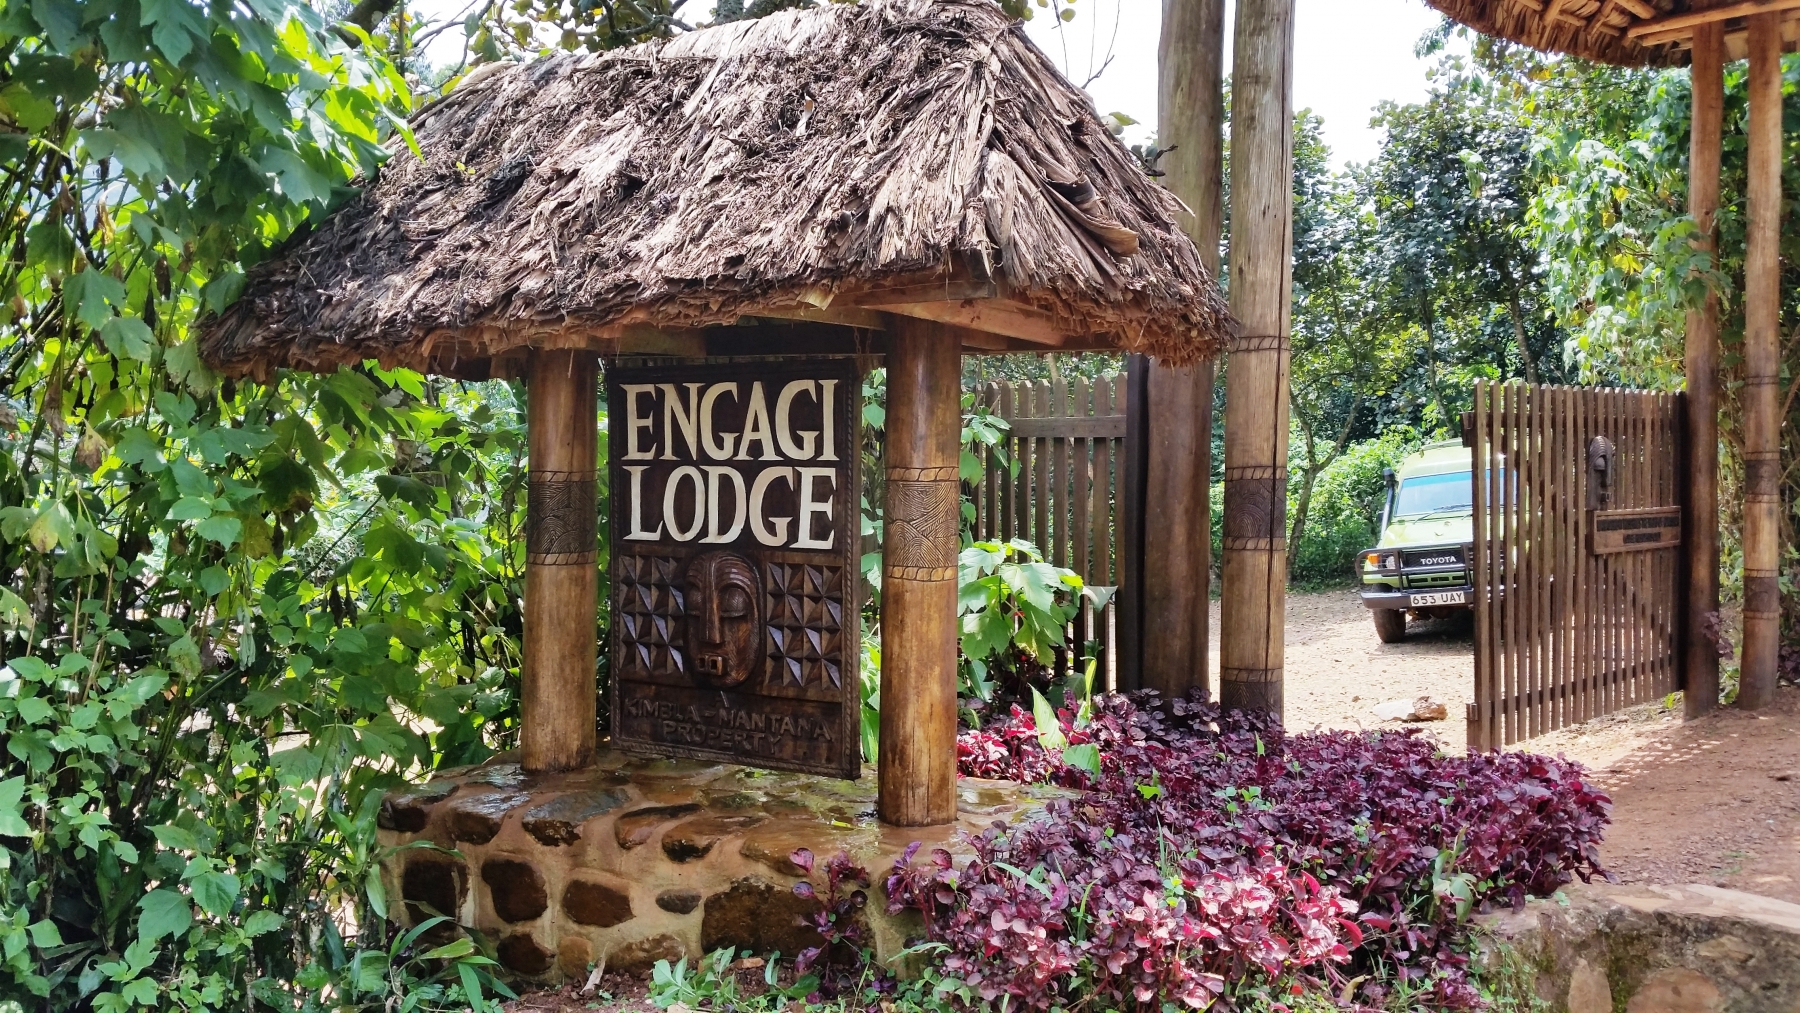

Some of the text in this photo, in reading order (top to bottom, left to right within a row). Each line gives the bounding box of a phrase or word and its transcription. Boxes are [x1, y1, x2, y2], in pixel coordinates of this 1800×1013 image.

[619, 379, 840, 461] ENGAGI
[622, 465, 837, 550] LODGE
[1420, 555, 1457, 566] TOYOTA
[1412, 592, 1464, 605] 653 UAY
[662, 719, 782, 754] PROPERTY
